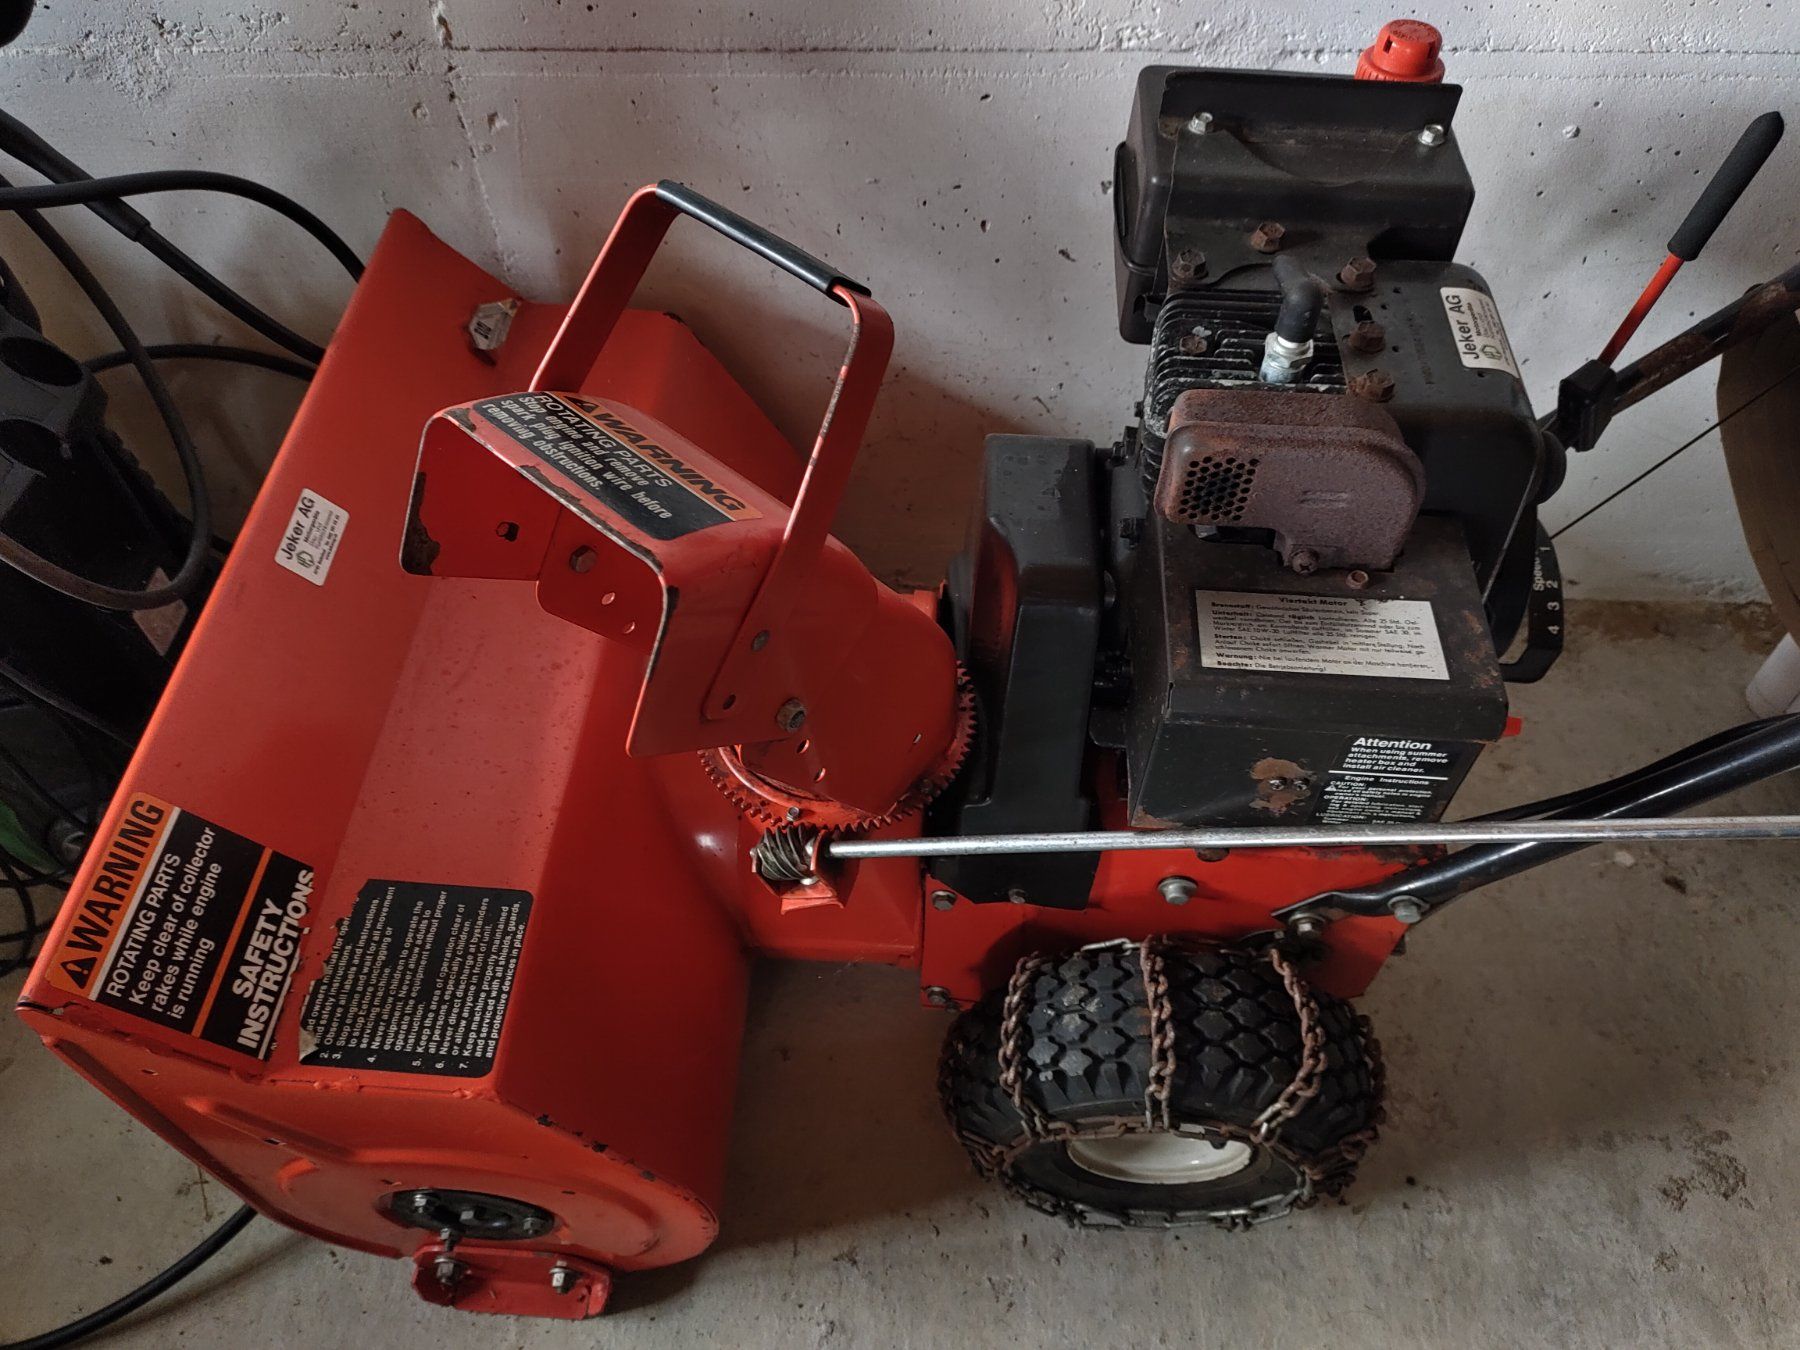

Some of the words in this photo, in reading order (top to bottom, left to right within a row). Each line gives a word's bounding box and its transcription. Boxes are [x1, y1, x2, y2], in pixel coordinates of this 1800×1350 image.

[1445, 295, 1465, 314] AG
[1456, 320, 1479, 359] Jeker
[481, 403, 535, 439] removing
[532, 440, 603, 489] obstructions.
[518, 396, 547, 413] Stop
[544, 415, 583, 439] engine
[581, 441, 610, 455] and
[604, 458, 649, 485] remove
[534, 396, 617, 450] ROTATING
[612, 450, 672, 486] PARTS
[500, 400, 536, 420] spark
[528, 422, 561, 439] plug
[553, 440, 603, 469] ignition
[602, 471, 633, 490] wire
[631, 491, 672, 518] before
[596, 412, 748, 512] WARNING
[298, 496, 315, 518] AG
[1545, 580, 1558, 588] 2
[1547, 601, 1559, 610] 3
[1547, 625, 1559, 634] 4
[1353, 737, 1431, 749] Attention
[1348, 753, 1408, 761] attachments,
[1379, 777, 1429, 785] Instructions
[67, 801, 163, 952] WARNING
[129, 959, 161, 1004] Keep
[152, 914, 178, 956] clear
[171, 893, 186, 912] of
[180, 827, 214, 893] collector
[376, 887, 395, 929] movement
[413, 901, 423, 913] the
[457, 904, 465, 913] of
[507, 901, 520, 931] guards,
[106, 910, 156, 996] ROTATING
[146, 853, 180, 907] PARTS
[385, 926, 393, 935] or
[404, 915, 419, 947] operate
[451, 914, 462, 935] clear
[470, 898, 489, 942] bystanders
[151, 965, 179, 1012] rakes
[172, 919, 198, 961] while
[192, 863, 221, 916] engine
[372, 930, 381, 941] all
[456, 919, 471, 955] children.
[479, 943, 487, 952] of
[233, 899, 282, 1002] SAFETY
[237, 868, 316, 1050] INSTRUCTIONS
[352, 948, 363, 964] and
[366, 942, 377, 954] for
[397, 970, 412, 997] Never
[408, 946, 420, 969] allow
[415, 919, 428, 944] adults
[422, 909, 431, 917] to
[400, 949, 409, 957] to
[439, 937, 456, 977] operation
[468, 944, 476, 952] at
[498, 933, 513, 965] shields,
[362, 955, 373, 973] wait
[369, 937, 391, 984] unclogging
[394, 1015, 410, 1051] operate
[404, 999, 415, 1013] the
[410, 951, 429, 997] equipment
[425, 919, 439, 949] without
[434, 891, 447, 917] proper
[472, 953, 484, 973] front
[495, 966, 503, 977] all
[167, 1004, 185, 1019] is
[178, 937, 215, 1001] running
[341, 966, 357, 992] labels
[356, 974, 367, 991] and
[389, 959, 405, 994] children
[435, 978, 444, 988] of
[443, 956, 462, 1000] especially
[455, 954, 474, 997] discharge
[462, 1032, 477, 1056] Keep
[471, 992, 486, 1030] machine
[481, 954, 497, 990] properly
[491, 906, 509, 952] maintained
[469, 975, 478, 983] in
[338, 994, 347, 1005] all
[429, 990, 441, 1010] area
[490, 979, 500, 997] with
[319, 997, 336, 1024] safety
[345, 993, 360, 1024] engine
[357, 986, 374, 1015] before
[359, 1007, 380, 1048] servicing
[373, 965, 391, 1005] machine.
[381, 996, 394, 1019] allow
[448, 999, 461, 1025] direct
[462, 985, 476, 1017] anyone
[485, 1040, 495, 1058] and
[490, 993, 507, 1038] protective
[502, 958, 516, 991] devices
[510, 948, 519, 956] in
[324, 1007, 343, 1045] Observe
[352, 1016, 365, 1036] stop
[423, 1012, 434, 1026] the
[432, 1002, 449, 1040] persons,
[479, 999, 495, 1037] serviced
[336, 1025, 351, 1046] Stop
[347, 1038, 357, 1047] to
[370, 1022, 386, 1049] Never
[415, 1028, 431, 1052] Keep
[439, 1026, 453, 1054] Never
[454, 1019, 466, 1043] allow
[319, 1050, 329, 1058] 2.
[331, 1051, 342, 1059] 3.
[428, 1042, 437, 1053] all
[452, 1045, 459, 1055] or
[474, 1039, 485, 1057] and
[411, 1058, 422, 1066] 5.
[435, 1060, 445, 1068] 6.
